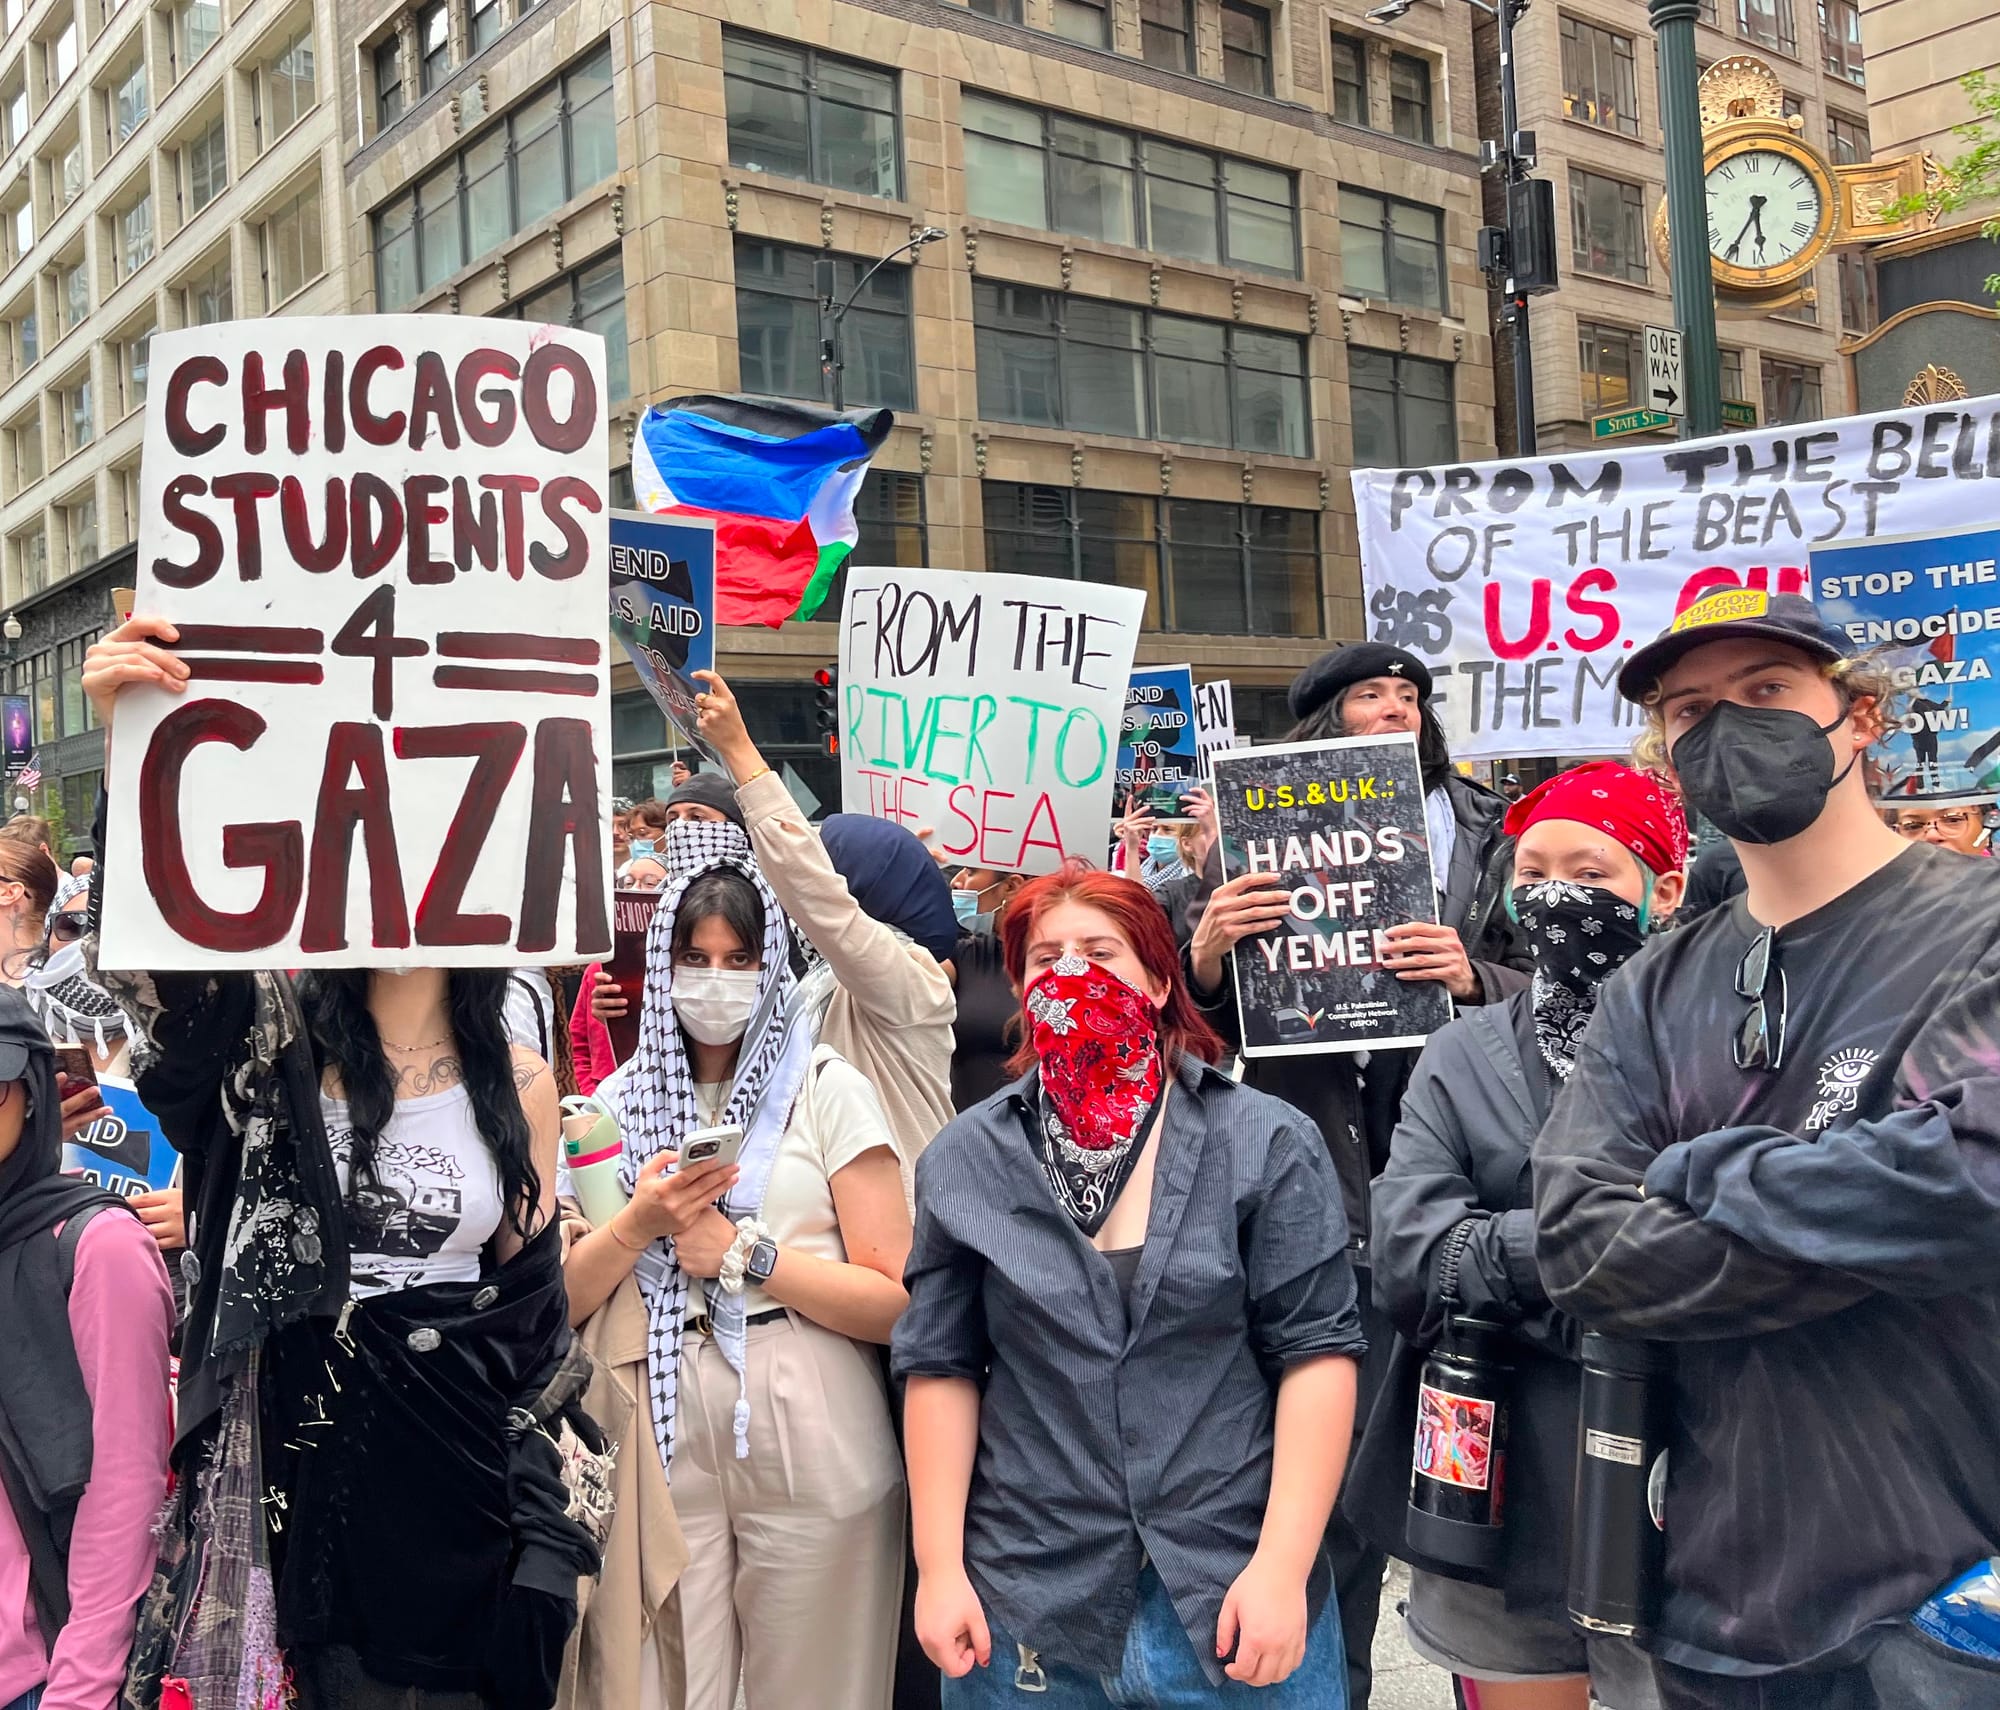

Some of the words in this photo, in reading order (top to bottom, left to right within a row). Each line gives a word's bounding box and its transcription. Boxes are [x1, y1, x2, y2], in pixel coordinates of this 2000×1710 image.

[1650, 334, 1678, 357] ONE
[1651, 357, 1679, 381] WAY
[165, 343, 597, 458] CHICAGO
[1608, 415, 1638, 433] STATE
[1390, 460, 1623, 532] FROM
[1664, 431, 1839, 493] THE
[152, 472, 602, 589] STUDENTS
[1425, 522, 1516, 583] OF
[1552, 499, 1671, 566] THE
[1696, 479, 1900, 551] BEAST
[610, 545, 670, 581] END
[1821, 571, 1913, 599] STOP
[1925, 560, 1997, 589] THE
[609, 596, 642, 626] .S.
[649, 602, 702, 637] AID
[1484, 567, 1634, 661] U.S.
[1838, 608, 2000, 645] ENOCIDE
[331, 583, 430, 721] 4
[849, 583, 982, 679] FROM
[1003, 600, 1127, 690] THE
[636, 642, 671, 675] TO
[1891, 658, 1992, 688] GAZA
[1193, 684, 1228, 732] EN
[1458, 657, 1564, 733] THE
[846, 684, 998, 786] RIVER
[1006, 696, 1108, 788] TO
[1149, 712, 1187, 729] AID
[1893, 708, 1969, 734] OW!
[1130, 741, 1161, 758] TO
[1115, 766, 1187, 784] ISRAEL
[139, 697, 612, 954] GAZA
[857, 770, 929, 825] THE
[942, 785, 1066, 868] SEA
[1247, 826, 1405, 873] HANDS
[1289, 880, 1375, 921] OFF
[1368, 1009, 1398, 1017] Network
